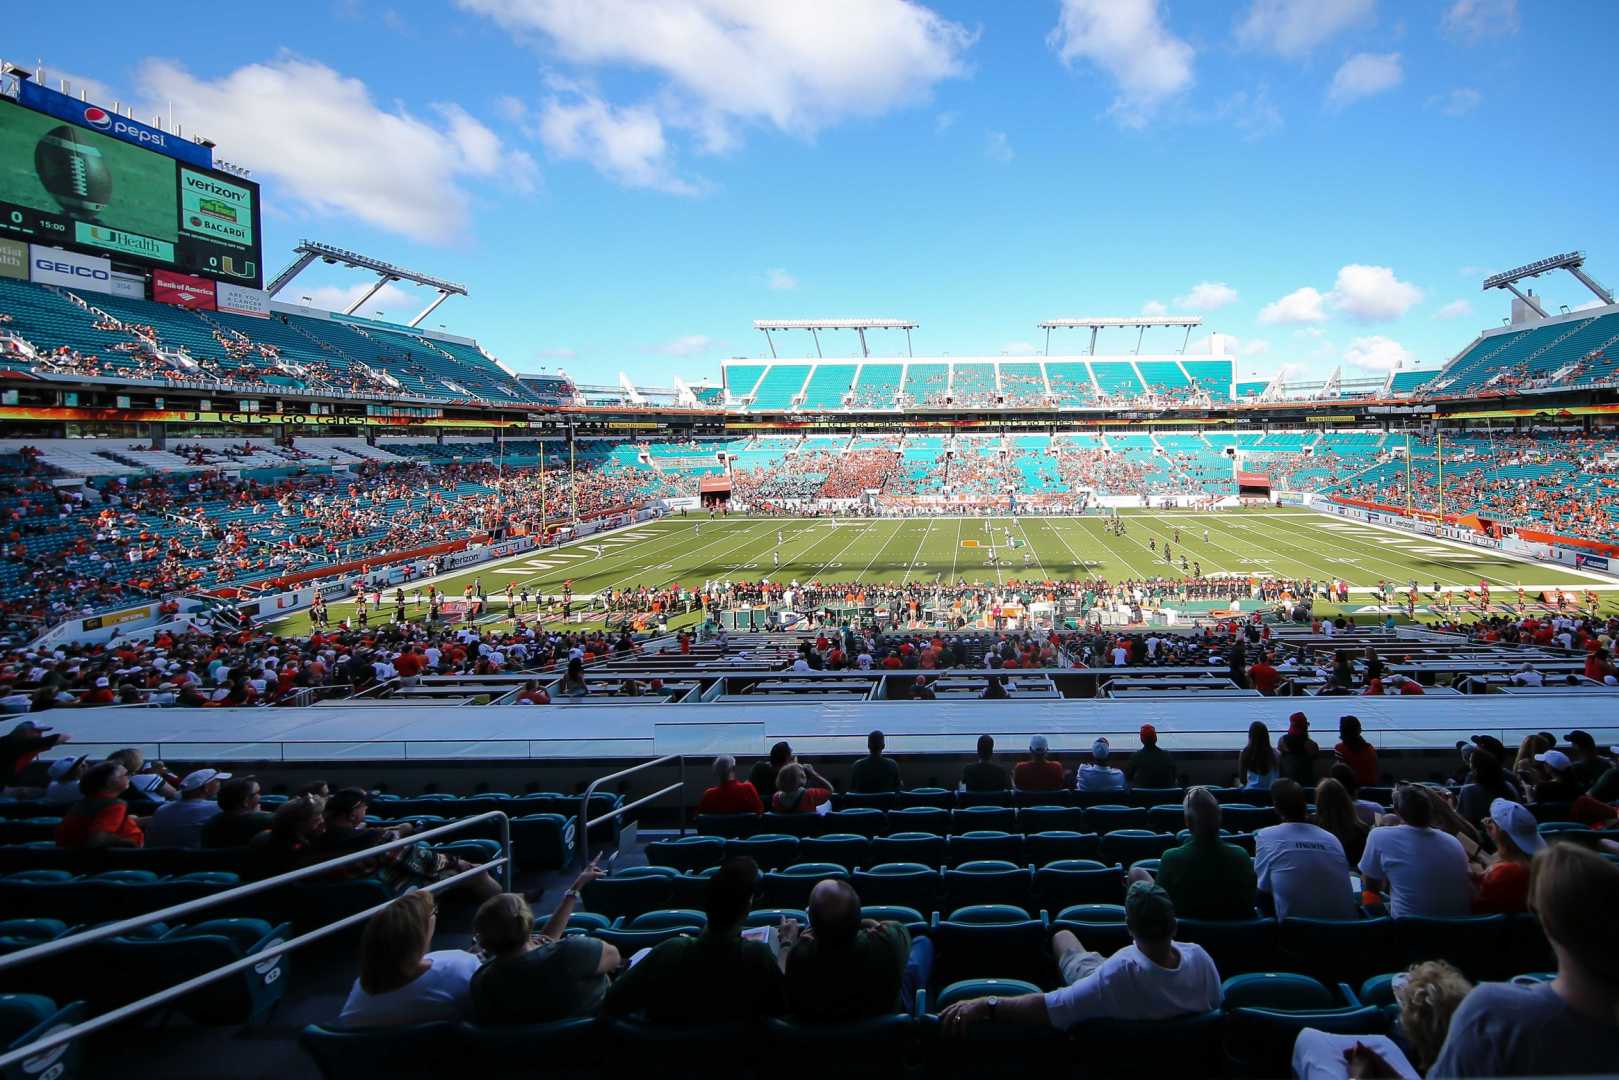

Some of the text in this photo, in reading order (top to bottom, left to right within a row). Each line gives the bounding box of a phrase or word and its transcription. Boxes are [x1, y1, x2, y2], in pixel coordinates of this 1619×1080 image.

[115, 122, 164, 146] pepsi
[187, 177, 240, 201] verizon
[11, 211, 23, 223] 0
[40, 221, 65, 231] 15:00
[36, 259, 109, 280] GEICO
[209, 256, 217, 267] 0
[157, 279, 176, 289] Bank
[185, 285, 214, 296] America
[452, 552, 480, 566] erizon
[490, 529, 670, 575] MIAMI
